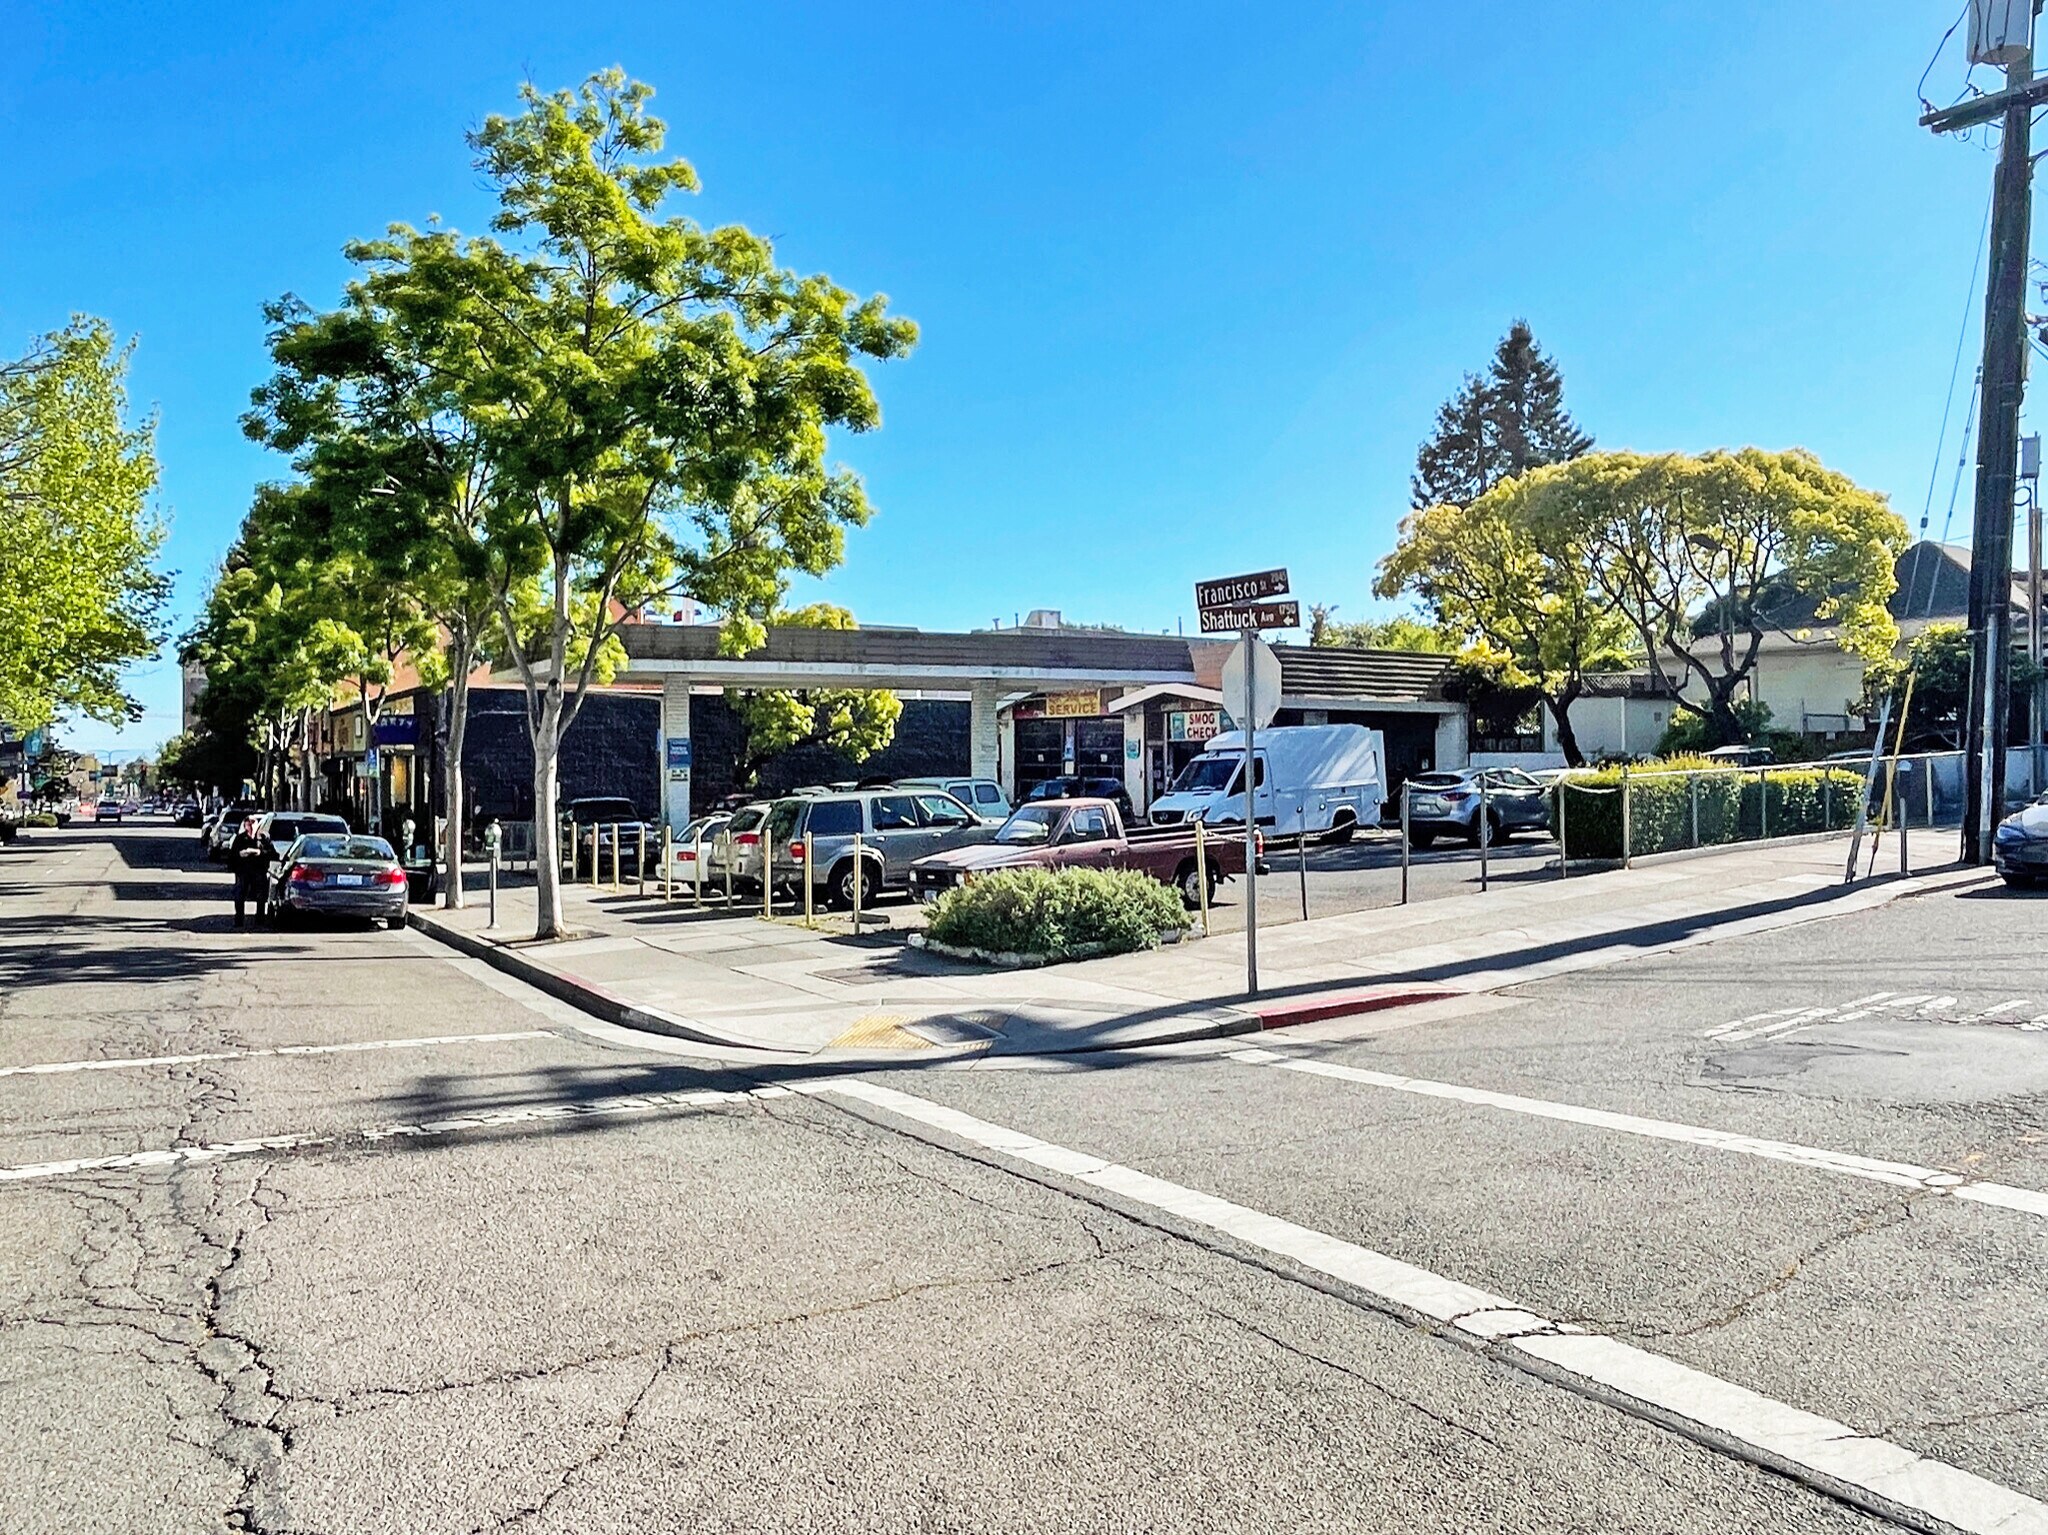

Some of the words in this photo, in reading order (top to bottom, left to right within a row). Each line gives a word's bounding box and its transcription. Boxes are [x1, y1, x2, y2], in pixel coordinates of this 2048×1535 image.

[1198, 581, 1258, 606] Francisco
[1201, 609, 1259, 631] Shattuck
[1261, 611, 1275, 622] Ave
[1048, 702, 1098, 715] SERVICE
[1189, 713, 1215, 725] SMOG
[1187, 726, 1217, 739] CHECK
